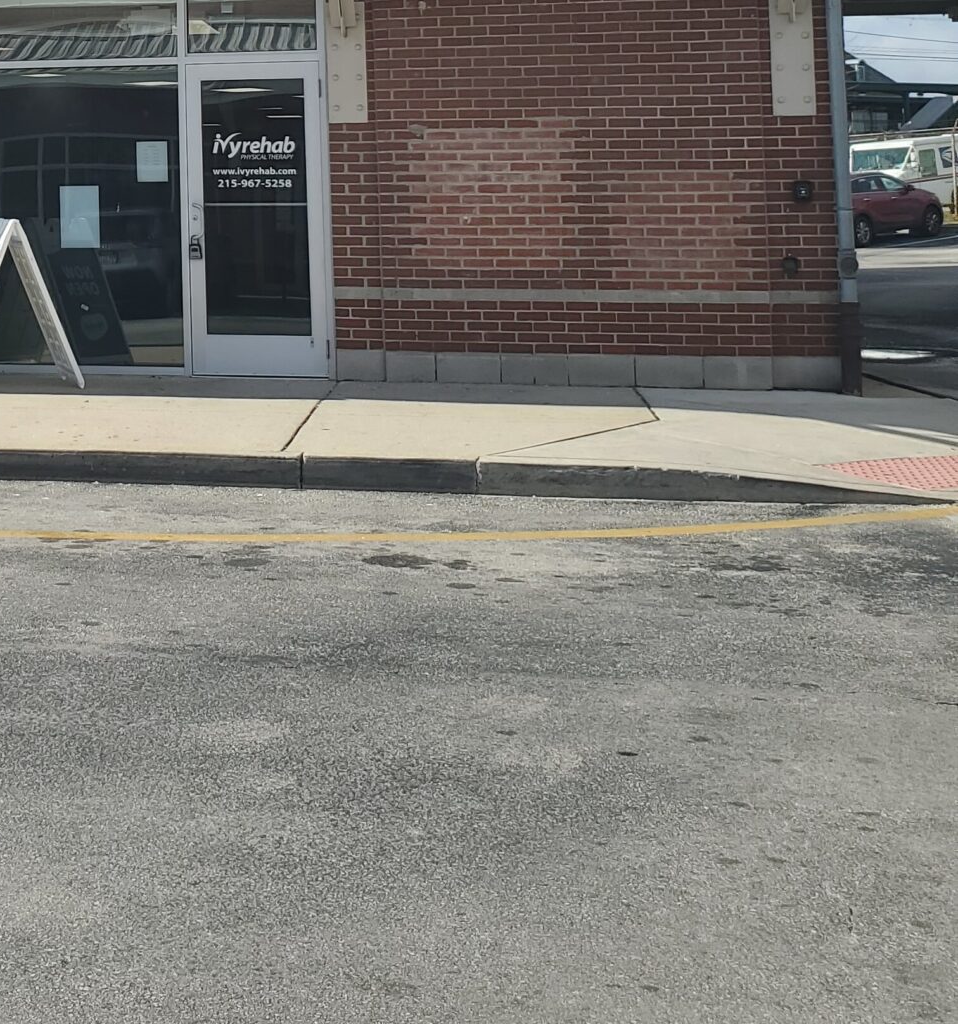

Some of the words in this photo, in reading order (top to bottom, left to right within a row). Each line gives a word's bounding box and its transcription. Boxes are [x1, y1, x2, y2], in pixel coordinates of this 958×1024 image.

[212, 132, 296, 158] ivyrehab
[212, 167, 297, 177] www.ivyrehab.com
[217, 179, 293, 188] 215-967-5258
